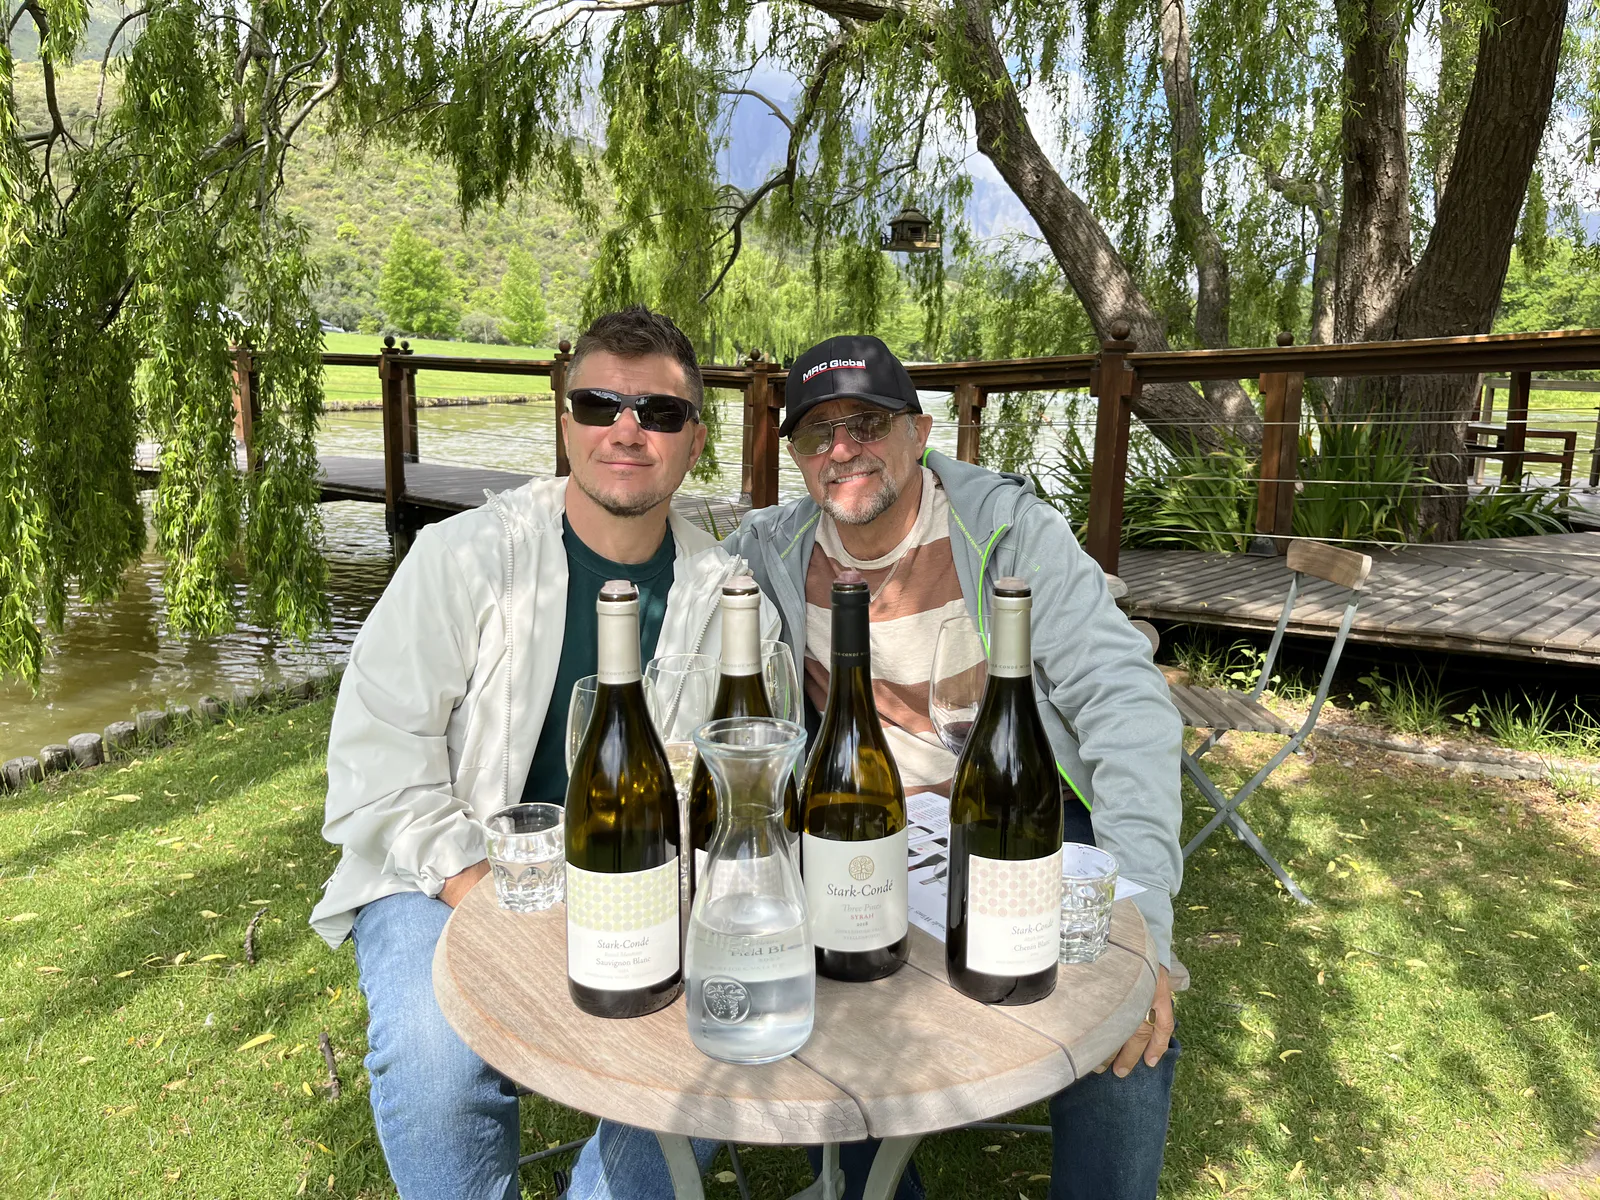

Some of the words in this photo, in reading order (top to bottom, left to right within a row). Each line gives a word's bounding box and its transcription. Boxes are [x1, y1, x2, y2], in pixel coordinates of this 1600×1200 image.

[802, 361, 828, 381] MRC
[829, 359, 866, 368] Global
[826, 878, 893, 897] Stark-Condé
[842, 903, 862, 912] Three
[863, 903, 882, 912] Pines
[850, 913, 874, 921] SYRAH
[597, 936, 650, 949] Stark-Condé
[1013, 942, 1037, 952] Chenin
[595, 957, 631, 968] Sauvignon
[632, 956, 651, 965] Blanc
